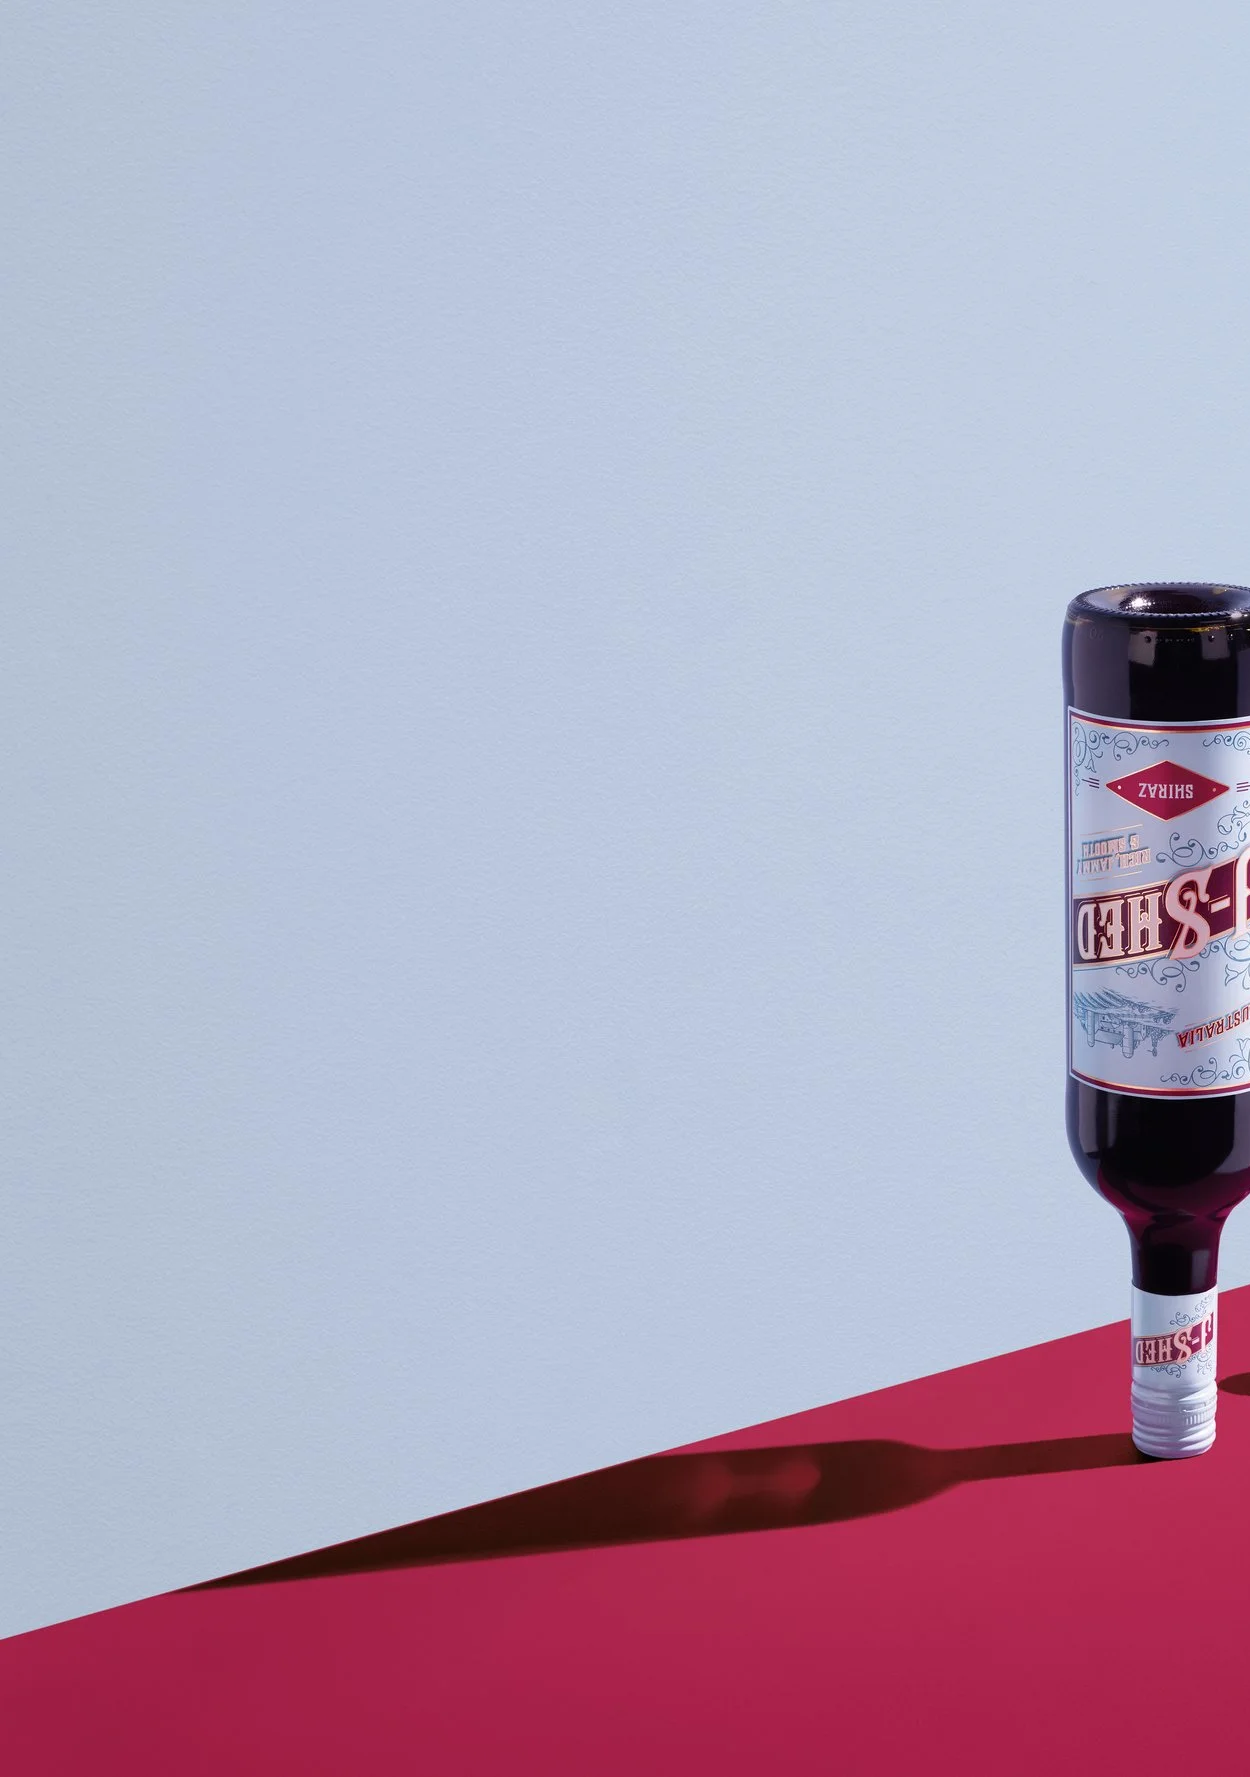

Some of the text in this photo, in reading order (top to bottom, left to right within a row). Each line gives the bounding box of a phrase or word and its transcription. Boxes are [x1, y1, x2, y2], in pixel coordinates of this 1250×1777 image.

[1138, 782, 1194, 799] SHIRAZ
[1082, 836, 1126, 858] SMOOTH
[1077, 856, 1112, 876] JAMMY
[1136, 1314, 1212, 1364] J-SHED
